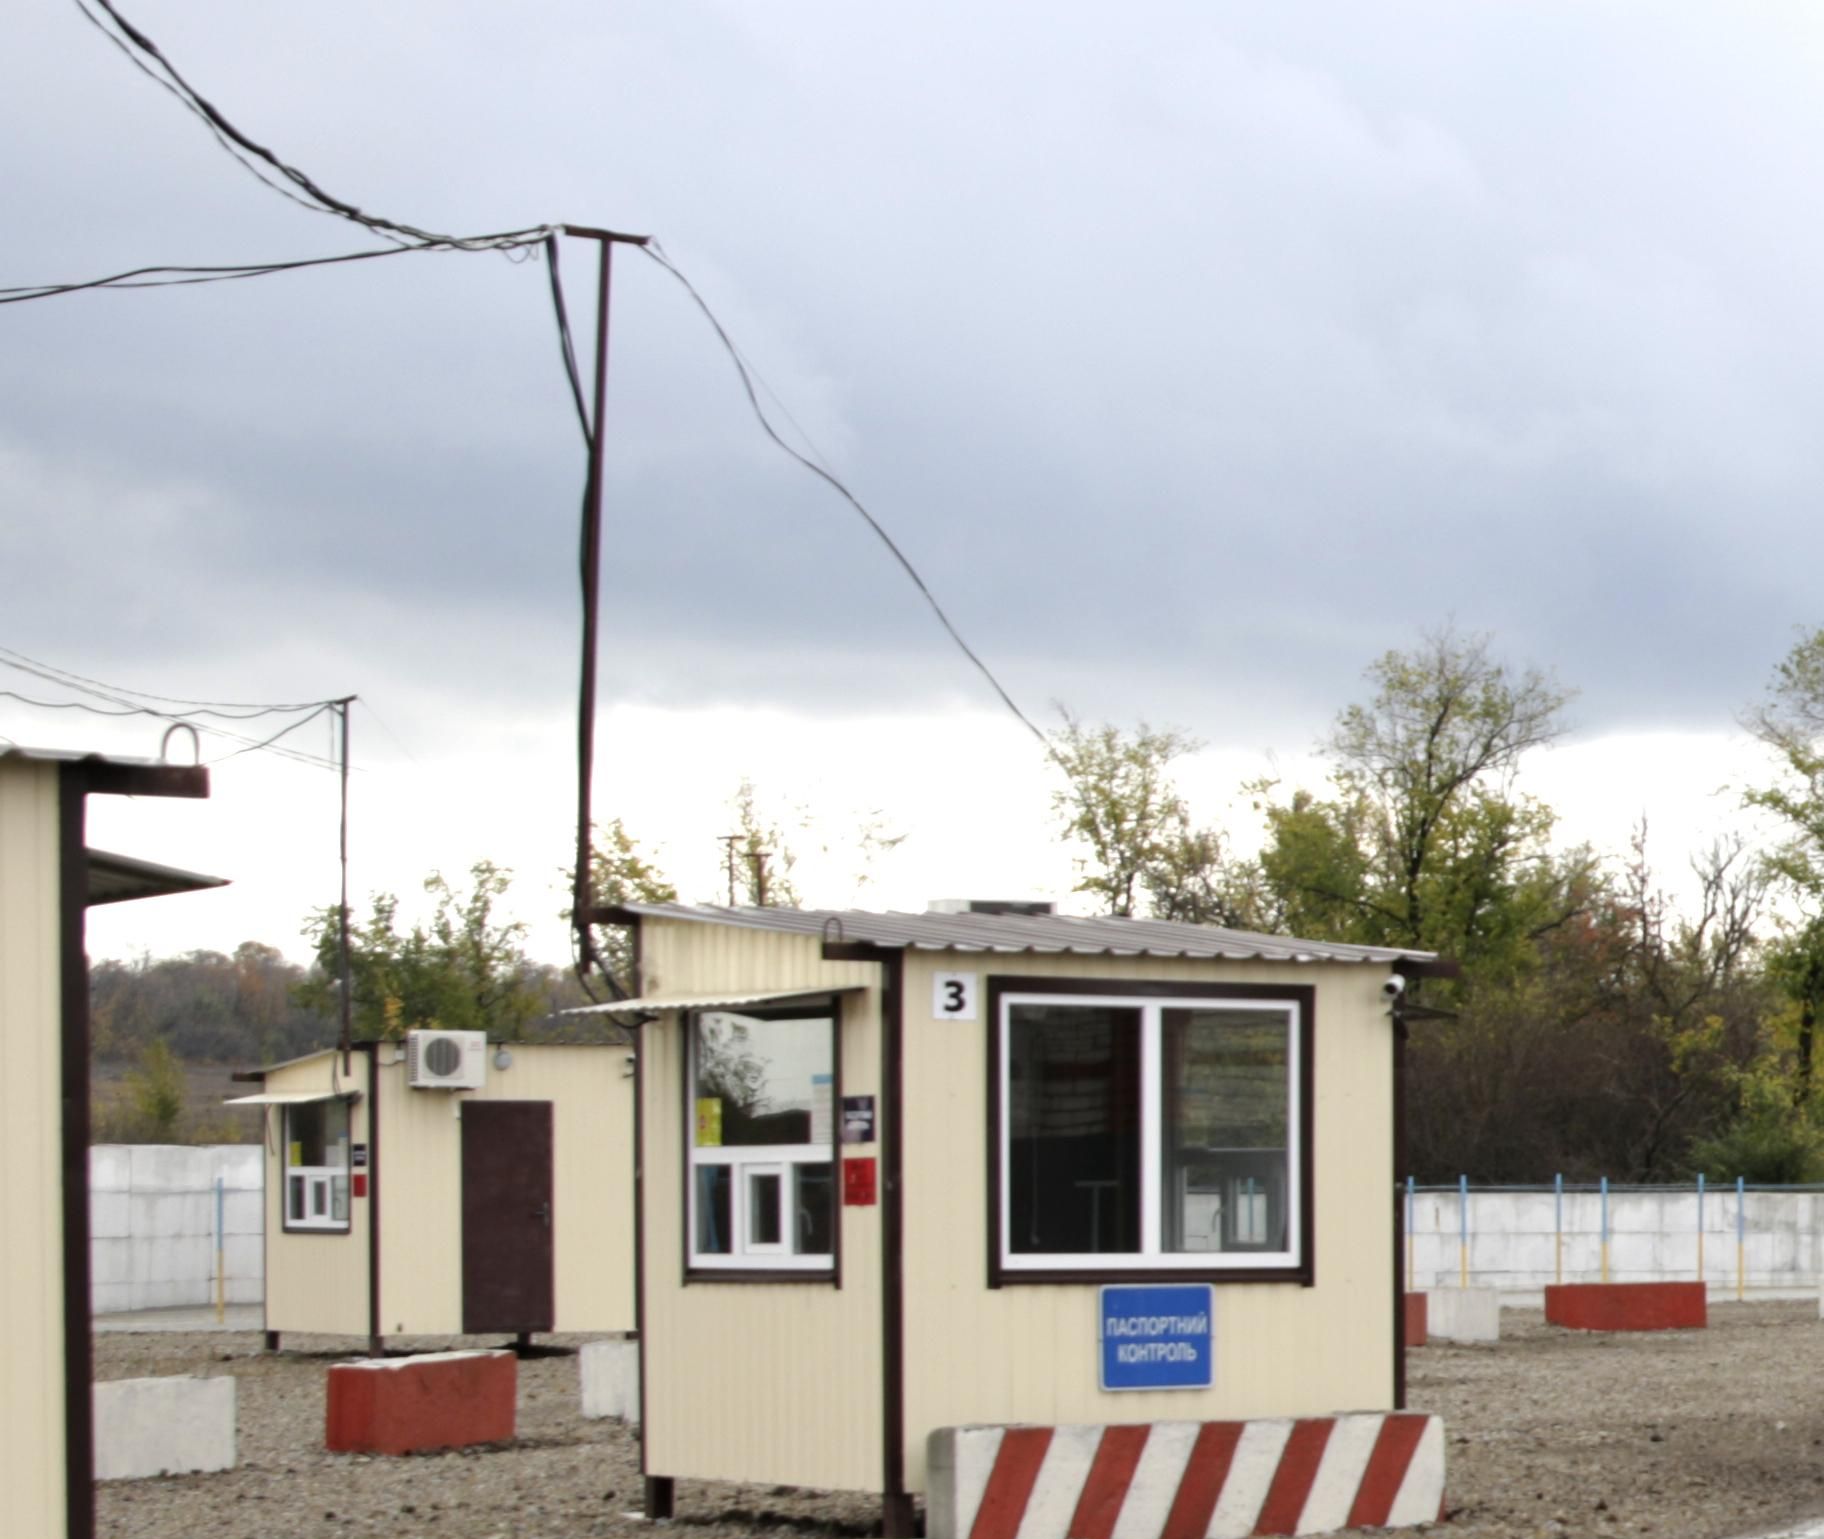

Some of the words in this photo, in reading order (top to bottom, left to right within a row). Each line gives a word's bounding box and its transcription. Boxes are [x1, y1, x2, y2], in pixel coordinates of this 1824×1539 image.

[944, 980, 966, 1013] 3
[1106, 1311, 1207, 1336] ПАСПОРТНИЙ
[1117, 1341, 1198, 1362] КОНТРОЛЬ
